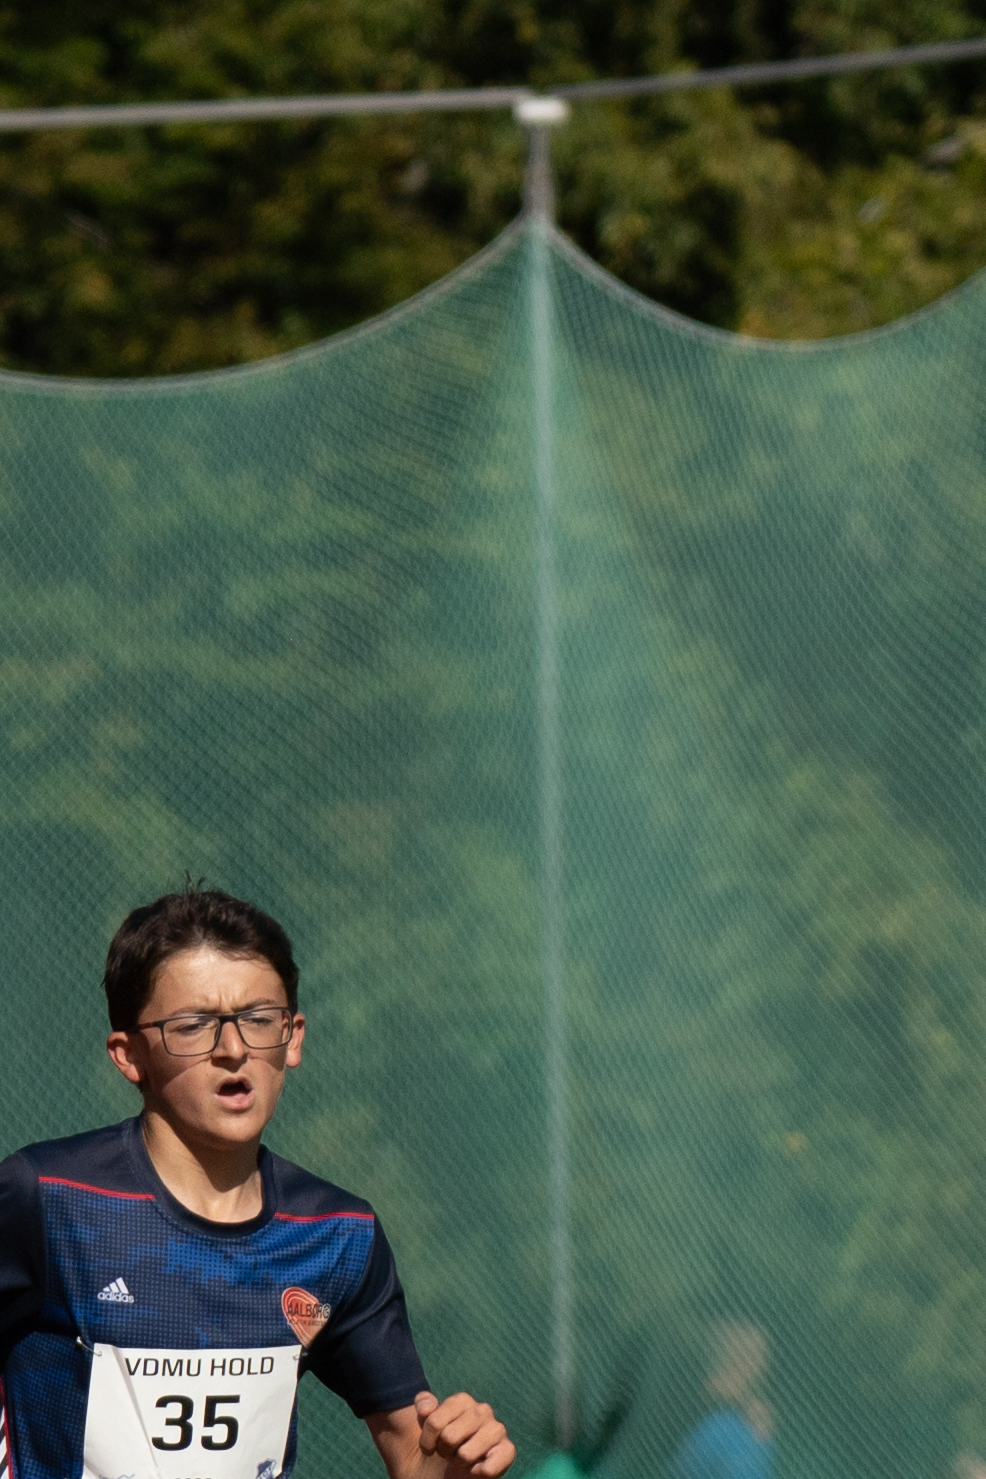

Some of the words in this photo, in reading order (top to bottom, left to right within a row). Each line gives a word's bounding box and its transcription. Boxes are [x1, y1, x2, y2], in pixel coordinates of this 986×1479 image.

[97, 1291, 134, 1304] adidas
[124, 1357, 202, 1377] VDMU
[210, 1356, 275, 1377] HOLD
[151, 1394, 241, 1452] 35
